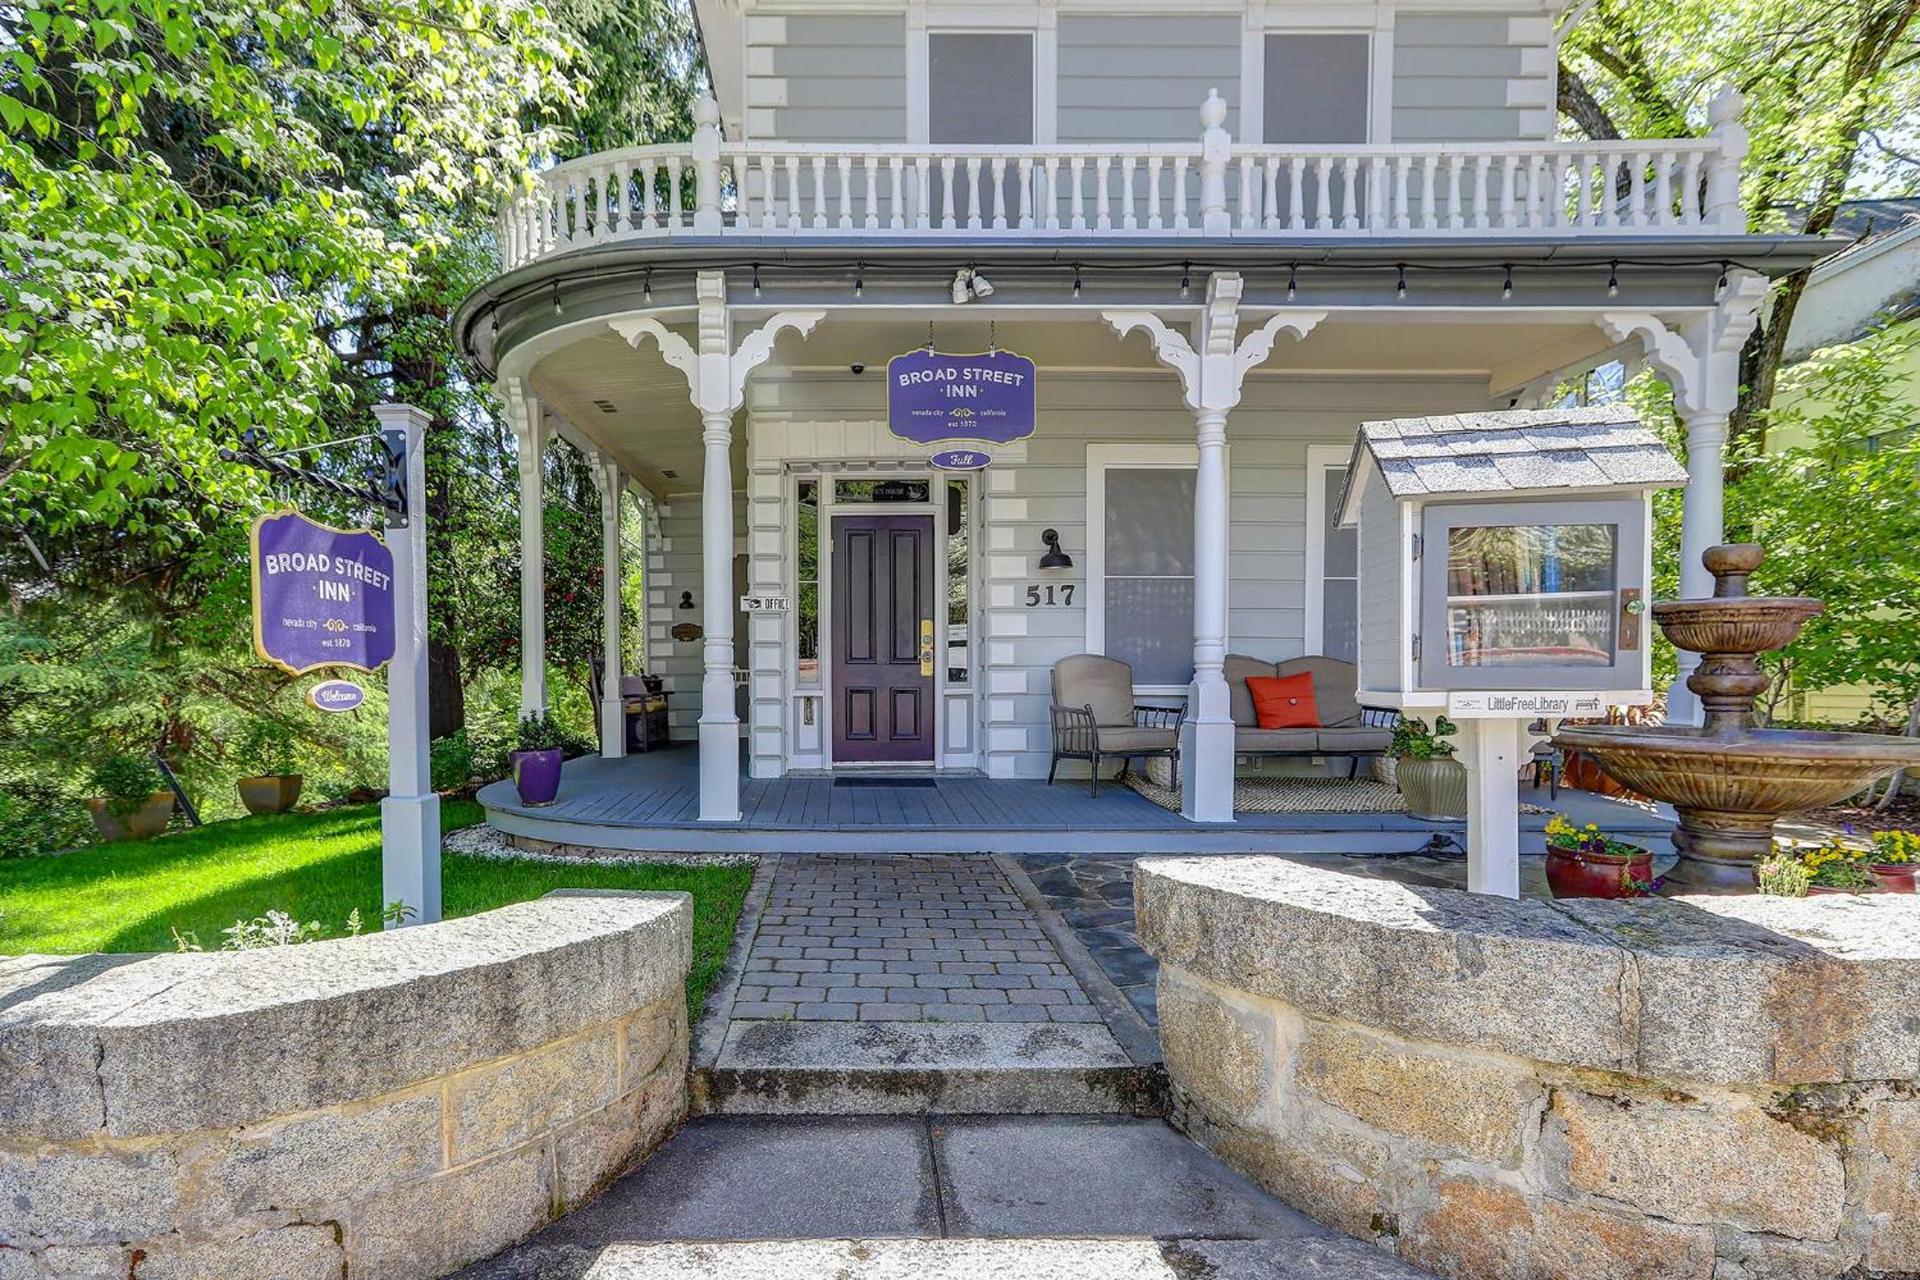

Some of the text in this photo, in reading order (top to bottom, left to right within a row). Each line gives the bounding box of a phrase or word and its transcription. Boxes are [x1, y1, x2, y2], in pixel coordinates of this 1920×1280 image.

[899, 368, 1024, 386] BROAD STREET
[946, 385, 977, 397] INN
[950, 454, 973, 465] Full
[265, 553, 390, 591] BROAD STREET
[319, 580, 350, 602] INN
[1025, 585, 1075, 607] 517
[282, 618, 317, 630] nevada city
[352, 623, 377, 632] california
[320, 689, 357, 702] Welcome
[1488, 697, 1569, 713] LittleFreeLibrary
